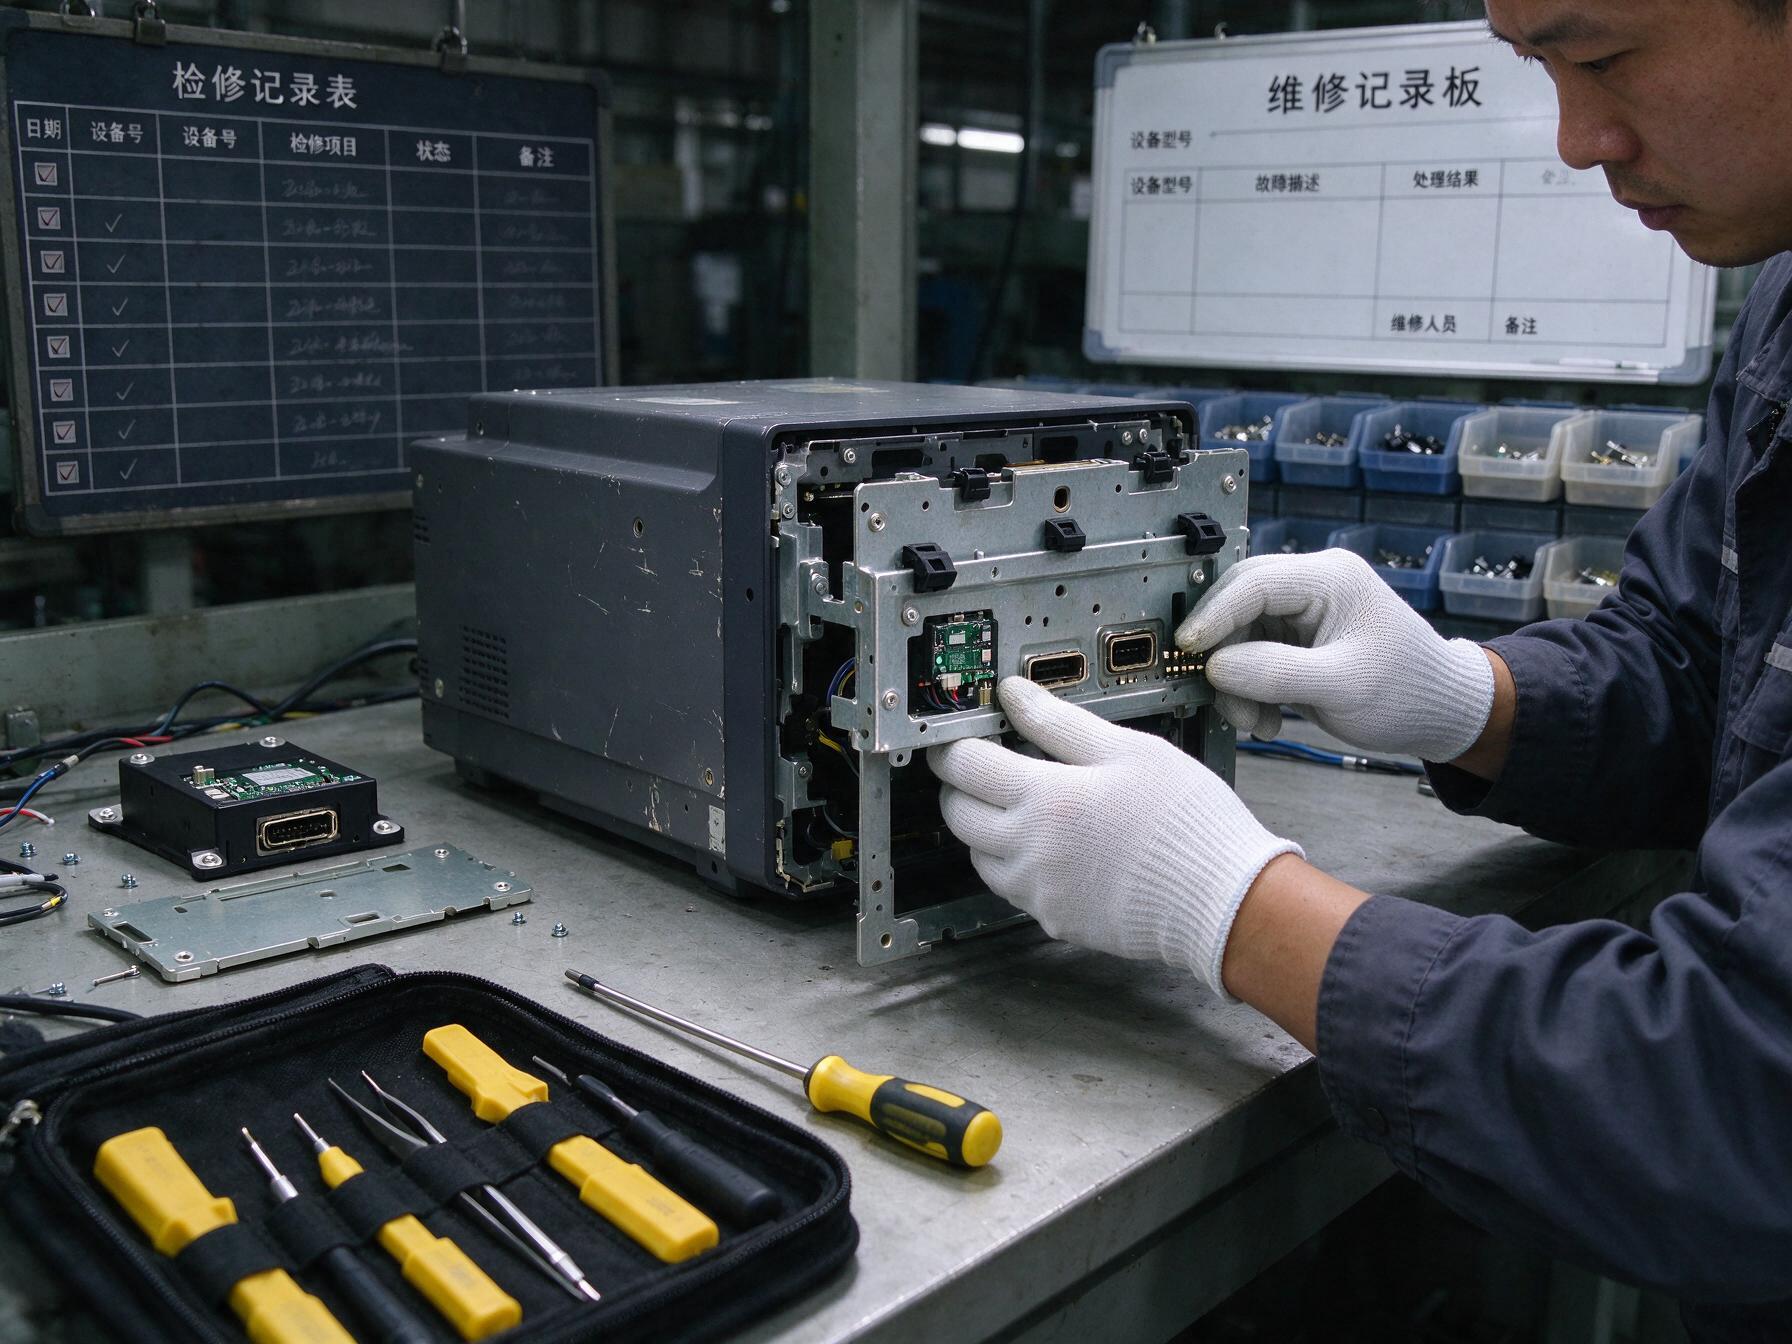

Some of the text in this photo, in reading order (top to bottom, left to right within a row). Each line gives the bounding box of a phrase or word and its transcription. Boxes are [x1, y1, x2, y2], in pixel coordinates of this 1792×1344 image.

[173, 61, 358, 109] 检修记录表
[1267, 65, 1482, 114] 维修记录板
[27, 118, 62, 140] 日期
[90, 121, 144, 143] 设备号
[183, 125, 237, 148] 设备号
[1130, 130, 1192, 150] 设备型号
[290, 132, 356, 156] 检修项目
[416, 139, 452, 162] 状态
[519, 145, 554, 168] 备注
[1130, 175, 1193, 195] 设备型号
[1413, 168, 1479, 189] 处理结果
[1390, 313, 1457, 334] 维修人员
[1505, 314, 1538, 336] 备注
